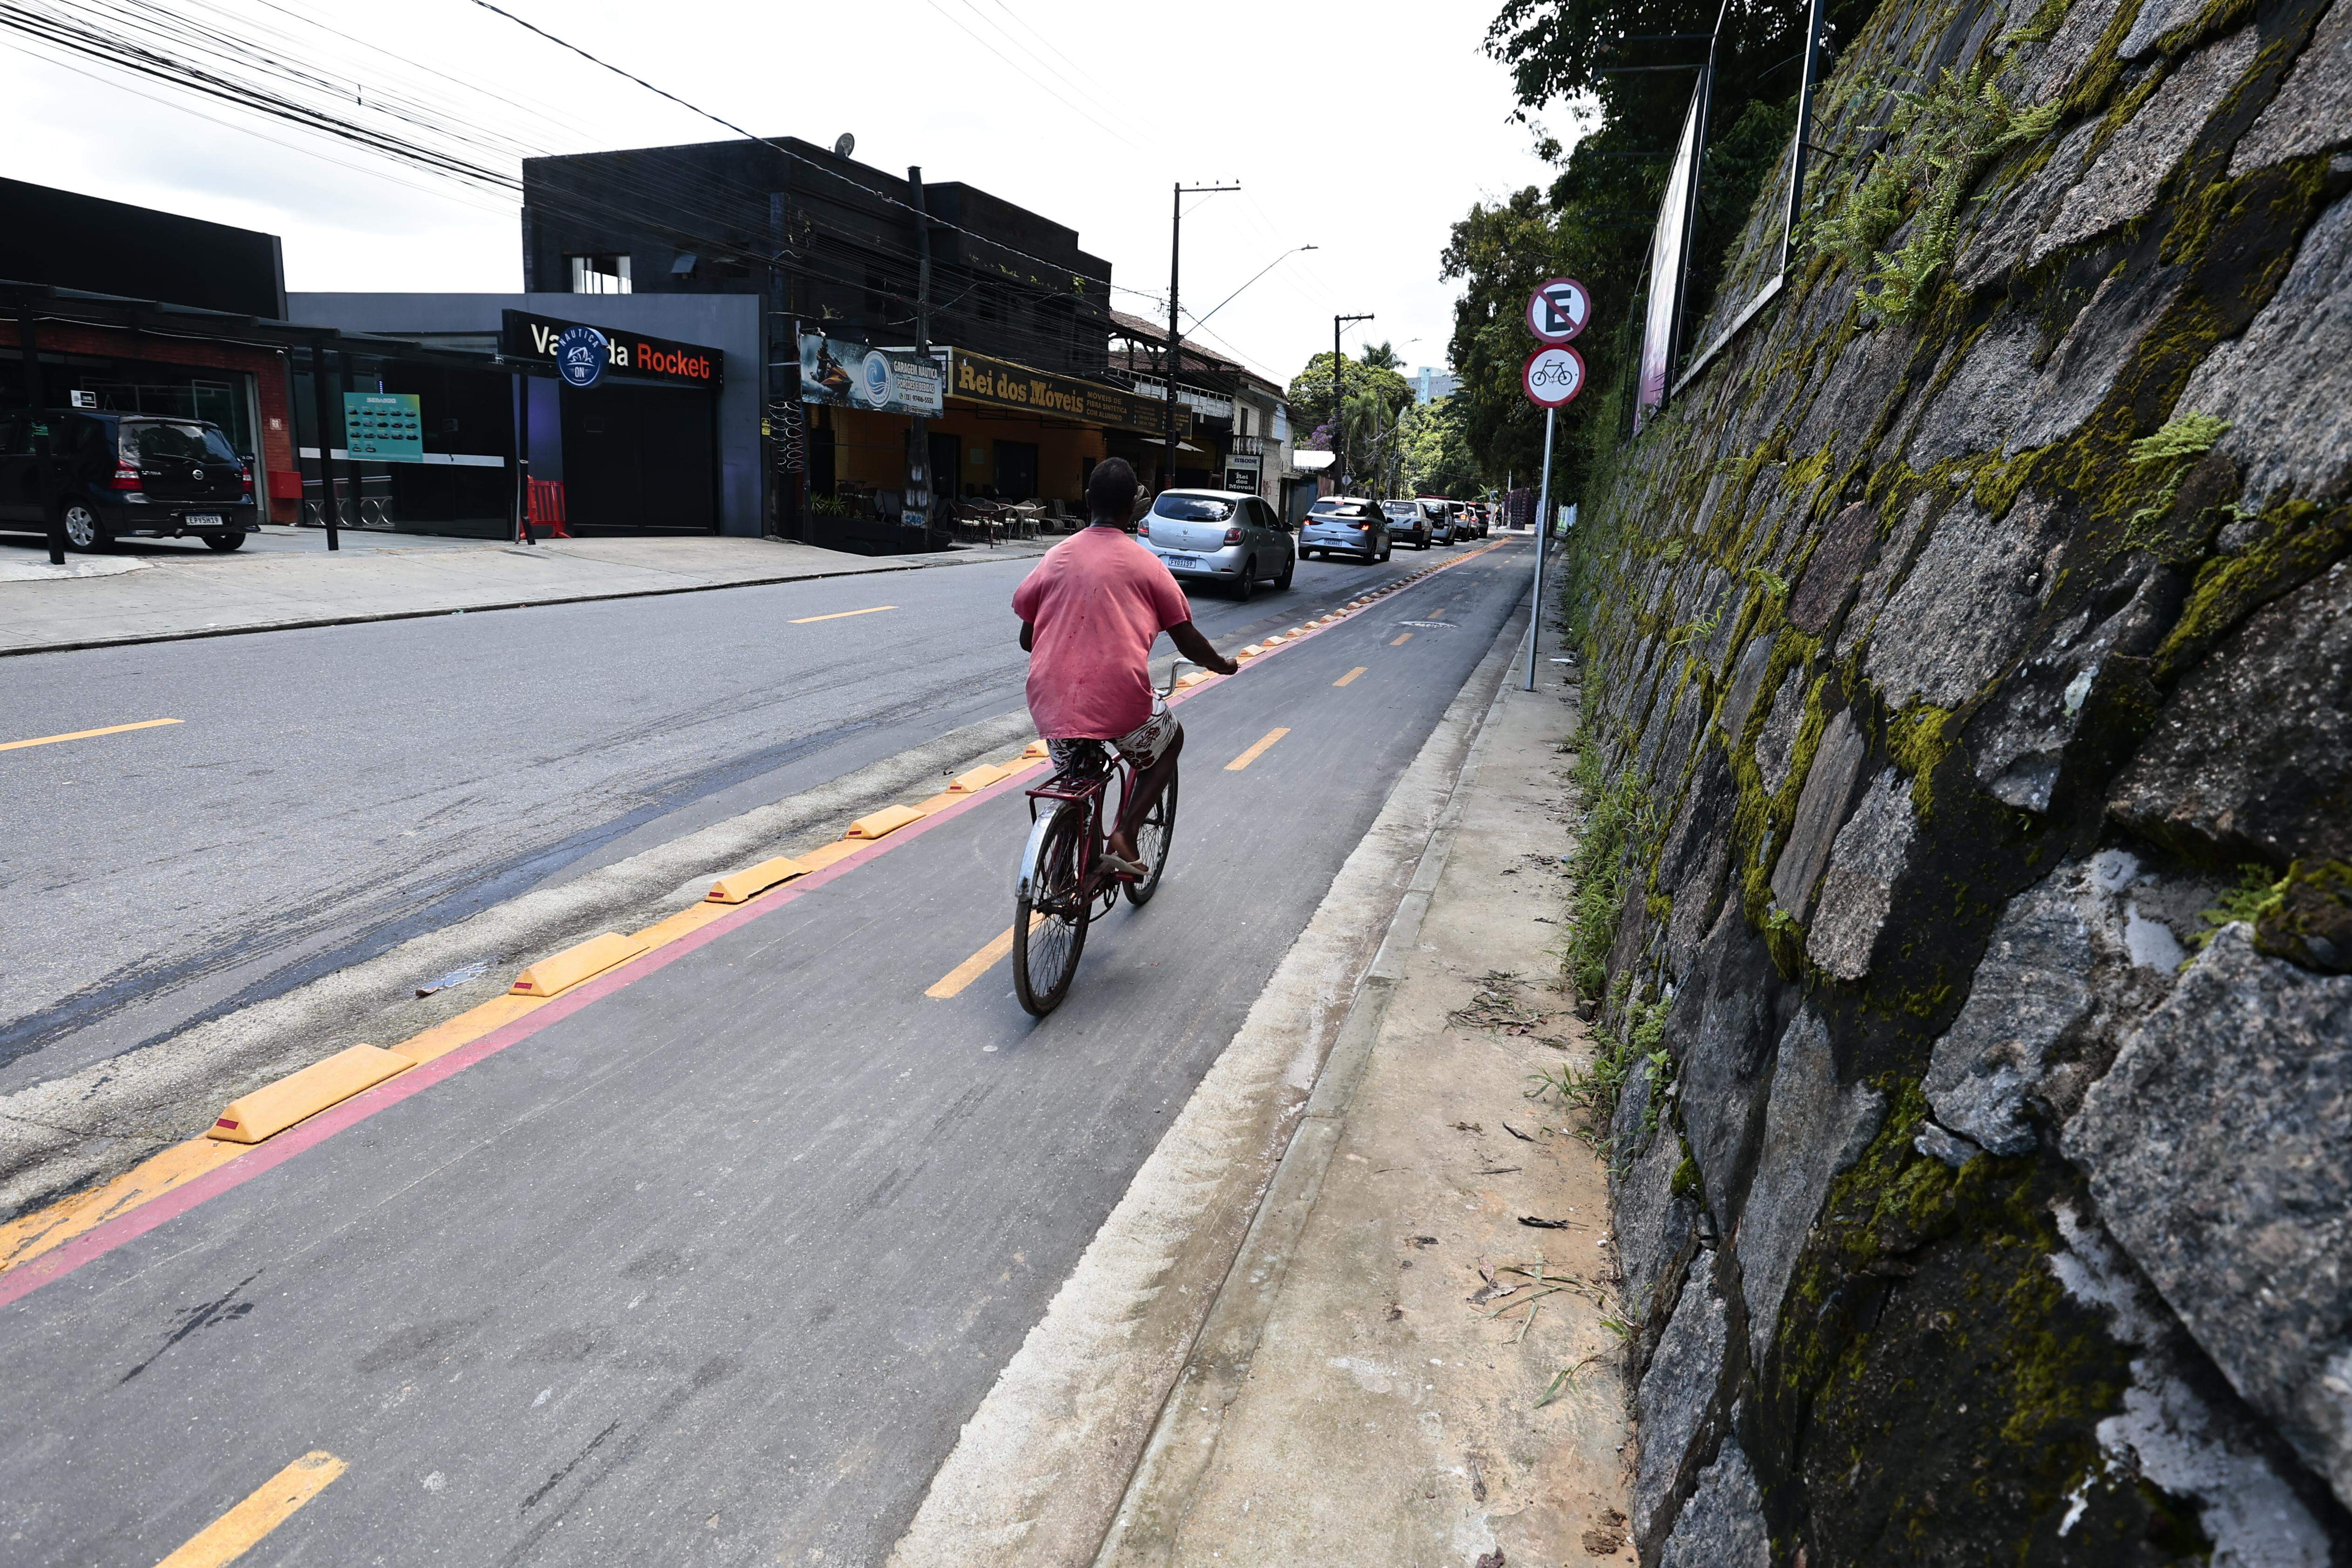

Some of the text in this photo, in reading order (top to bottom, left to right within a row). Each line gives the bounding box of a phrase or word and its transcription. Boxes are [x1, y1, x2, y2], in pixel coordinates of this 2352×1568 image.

[1546, 290, 1571, 332] E
[559, 328, 599, 348] NAUTICA
[637, 343, 710, 379] Rocket
[894, 360, 938, 380] GARAGEM NÁUTICA
[575, 367, 584, 378] ON
[897, 377, 915, 392] PORÇÕES
[915, 380, 919, 391] E
[919, 381, 935, 393] BEBIDAS
[958, 364, 1084, 413] Rei dos Móveis
[1087, 400, 1102, 409] FIBRA
